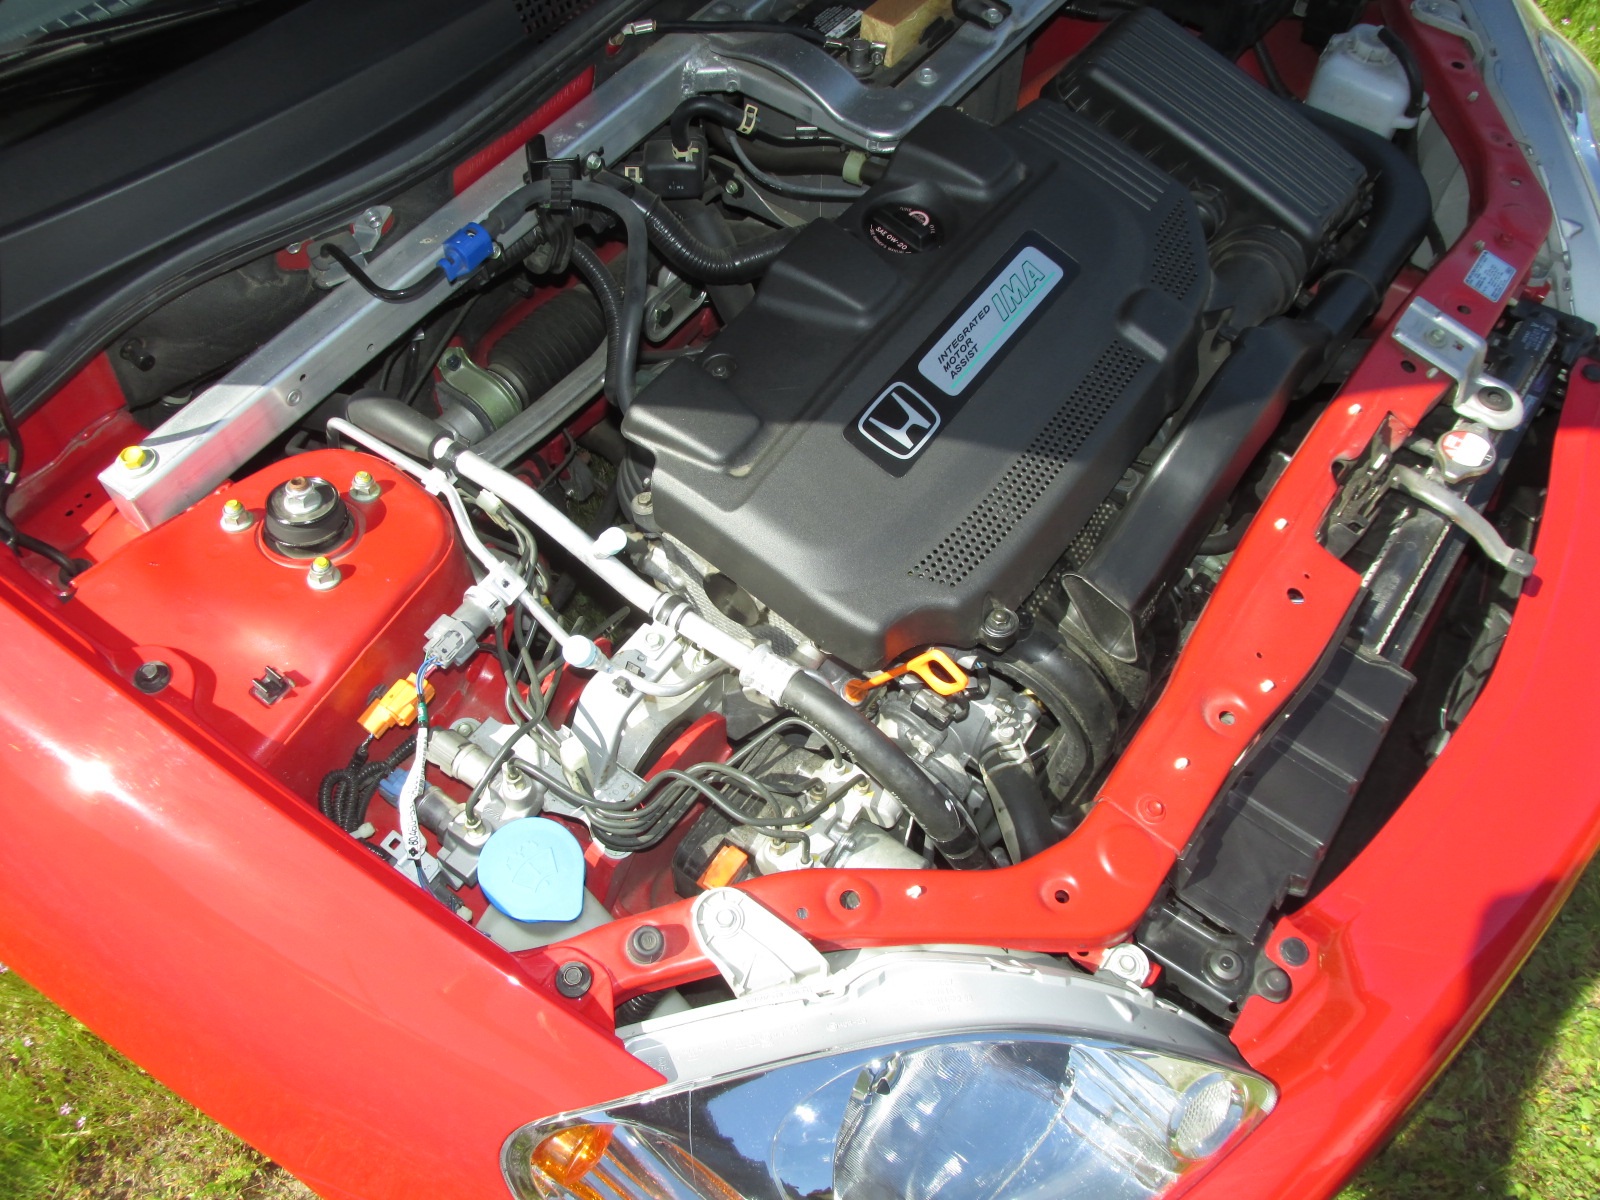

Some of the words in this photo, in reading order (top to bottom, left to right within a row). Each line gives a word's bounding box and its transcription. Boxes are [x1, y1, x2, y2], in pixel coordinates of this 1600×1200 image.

[875, 226, 888, 236] SAE
[991, 260, 1046, 322] IMA
[937, 304, 991, 365] INTEGRATED
[943, 337, 974, 373] MOTOR
[949, 343, 979, 380] ASSIST
